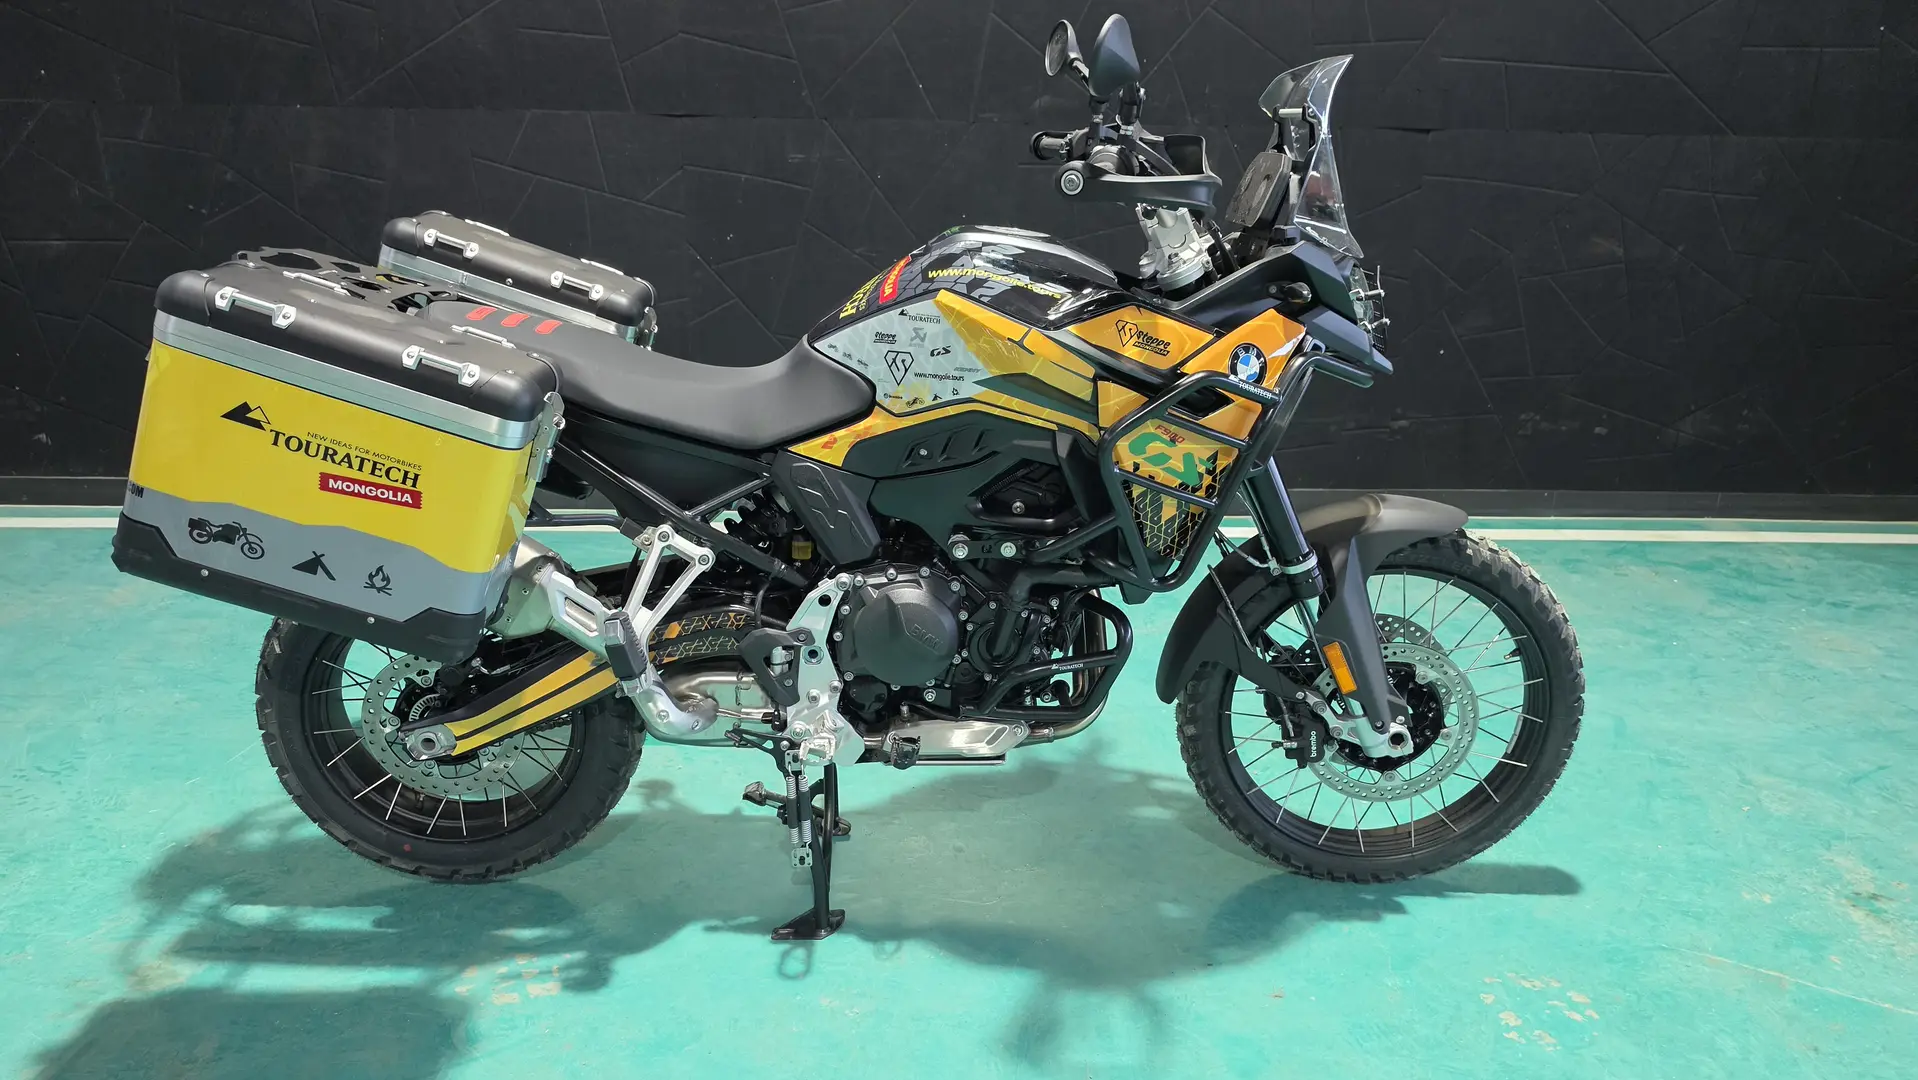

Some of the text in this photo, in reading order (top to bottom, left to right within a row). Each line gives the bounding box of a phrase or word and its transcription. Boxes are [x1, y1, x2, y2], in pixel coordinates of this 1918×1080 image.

[908, 314, 941, 324] TOURATECH
[930, 345, 951, 357] GS
[269, 429, 421, 489] TOURATECH
[307, 431, 422, 471] NEW IDEAS FOR MOTORBIKES
[328, 478, 413, 504] MONGOLIA
[1309, 730, 1317, 758] brembo
